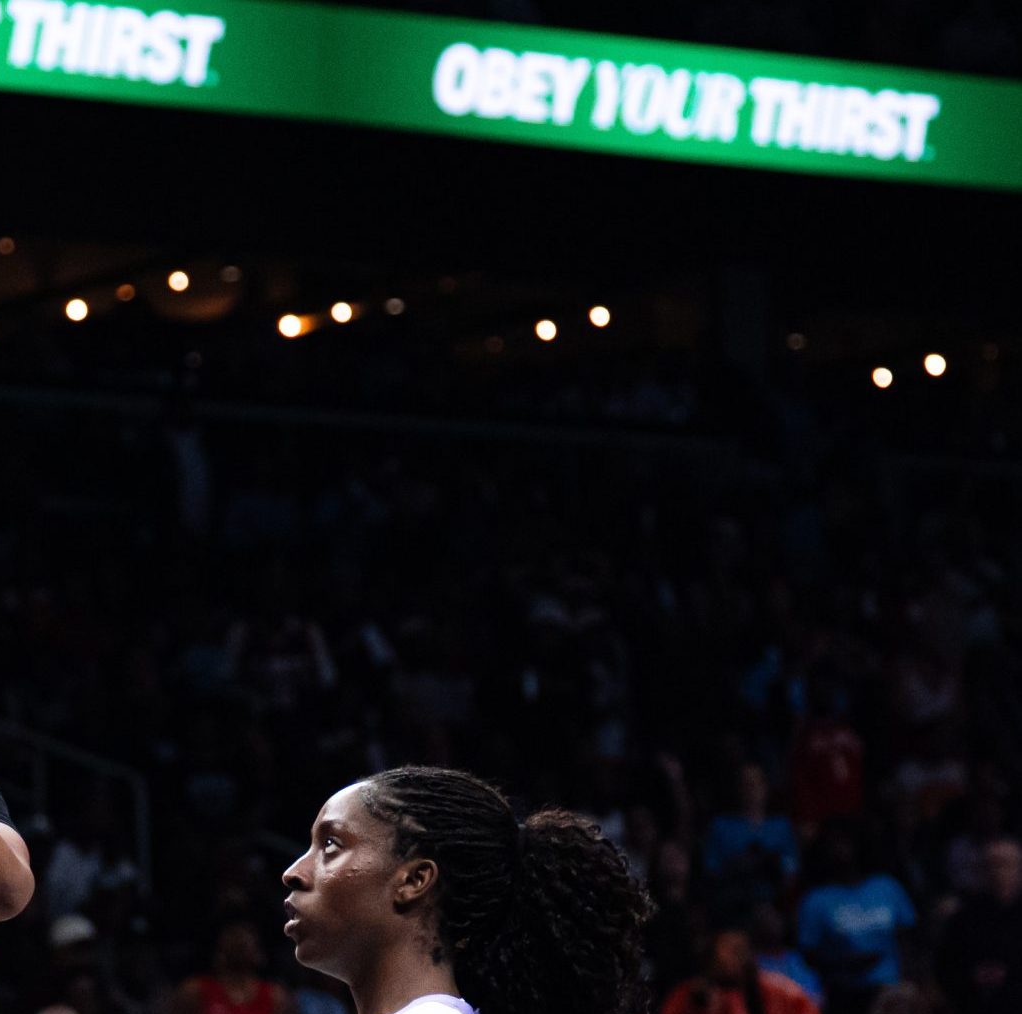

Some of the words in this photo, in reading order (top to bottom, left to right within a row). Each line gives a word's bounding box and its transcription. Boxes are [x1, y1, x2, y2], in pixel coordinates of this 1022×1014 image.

[7, 0, 224, 86] THIRST
[432, 43, 591, 126] OBEY
[589, 60, 746, 143] YOUR
[748, 77, 939, 161] THIRST
